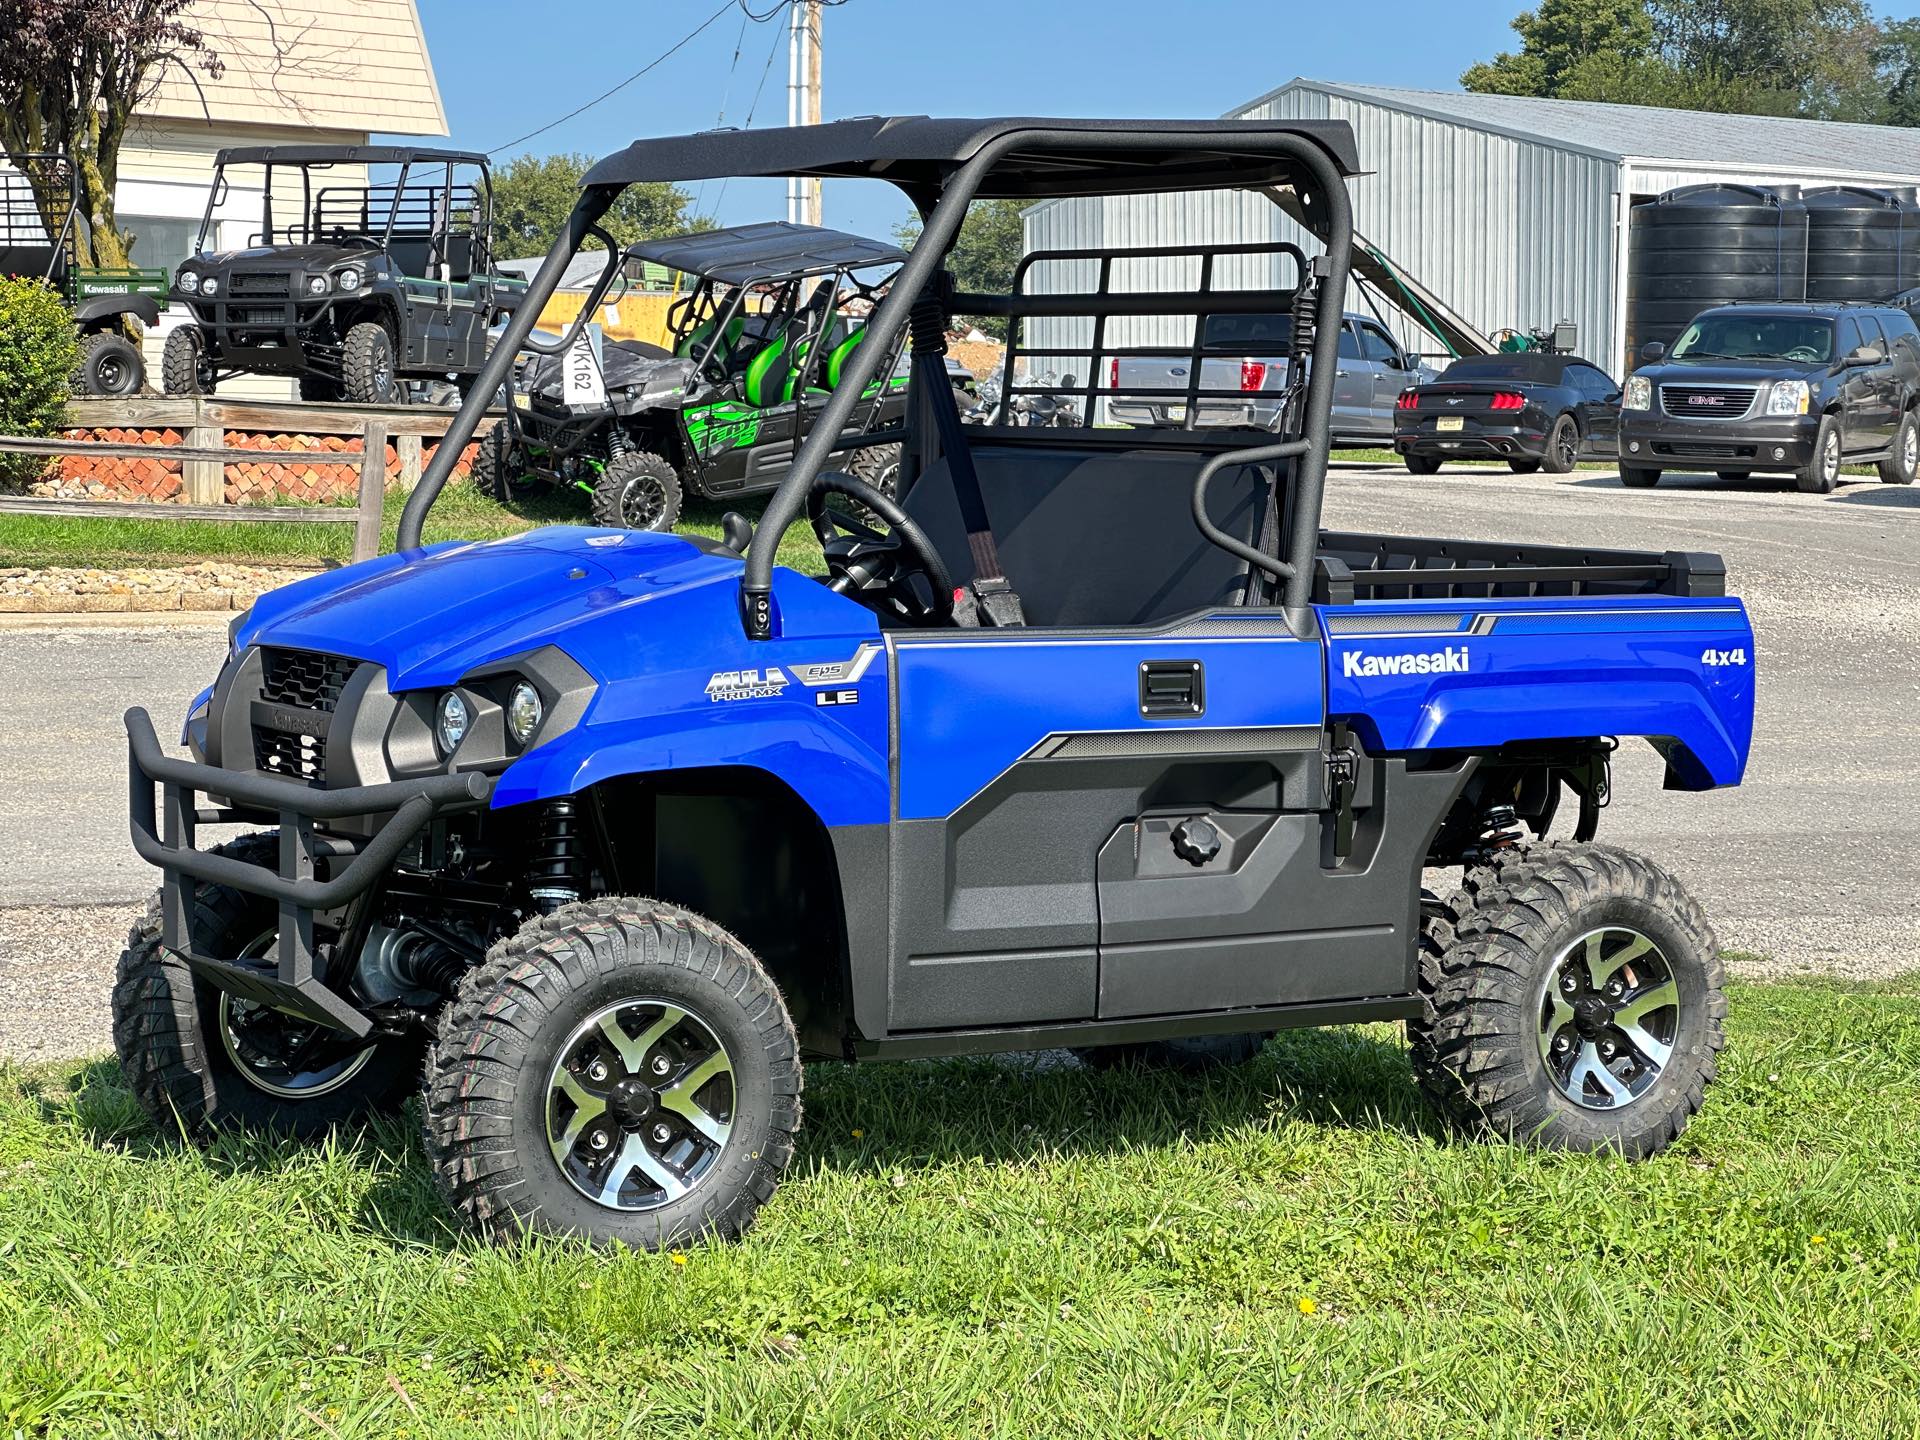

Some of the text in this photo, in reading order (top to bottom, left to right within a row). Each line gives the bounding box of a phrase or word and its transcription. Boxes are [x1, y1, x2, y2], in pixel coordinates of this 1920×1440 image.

[84, 284, 128, 293] Kawasaki
[1688, 395, 1725, 406] GMC
[1343, 646, 1469, 677] Kawasaki
[1701, 648, 1747, 666] 4x4
[816, 690, 858, 706] LE
